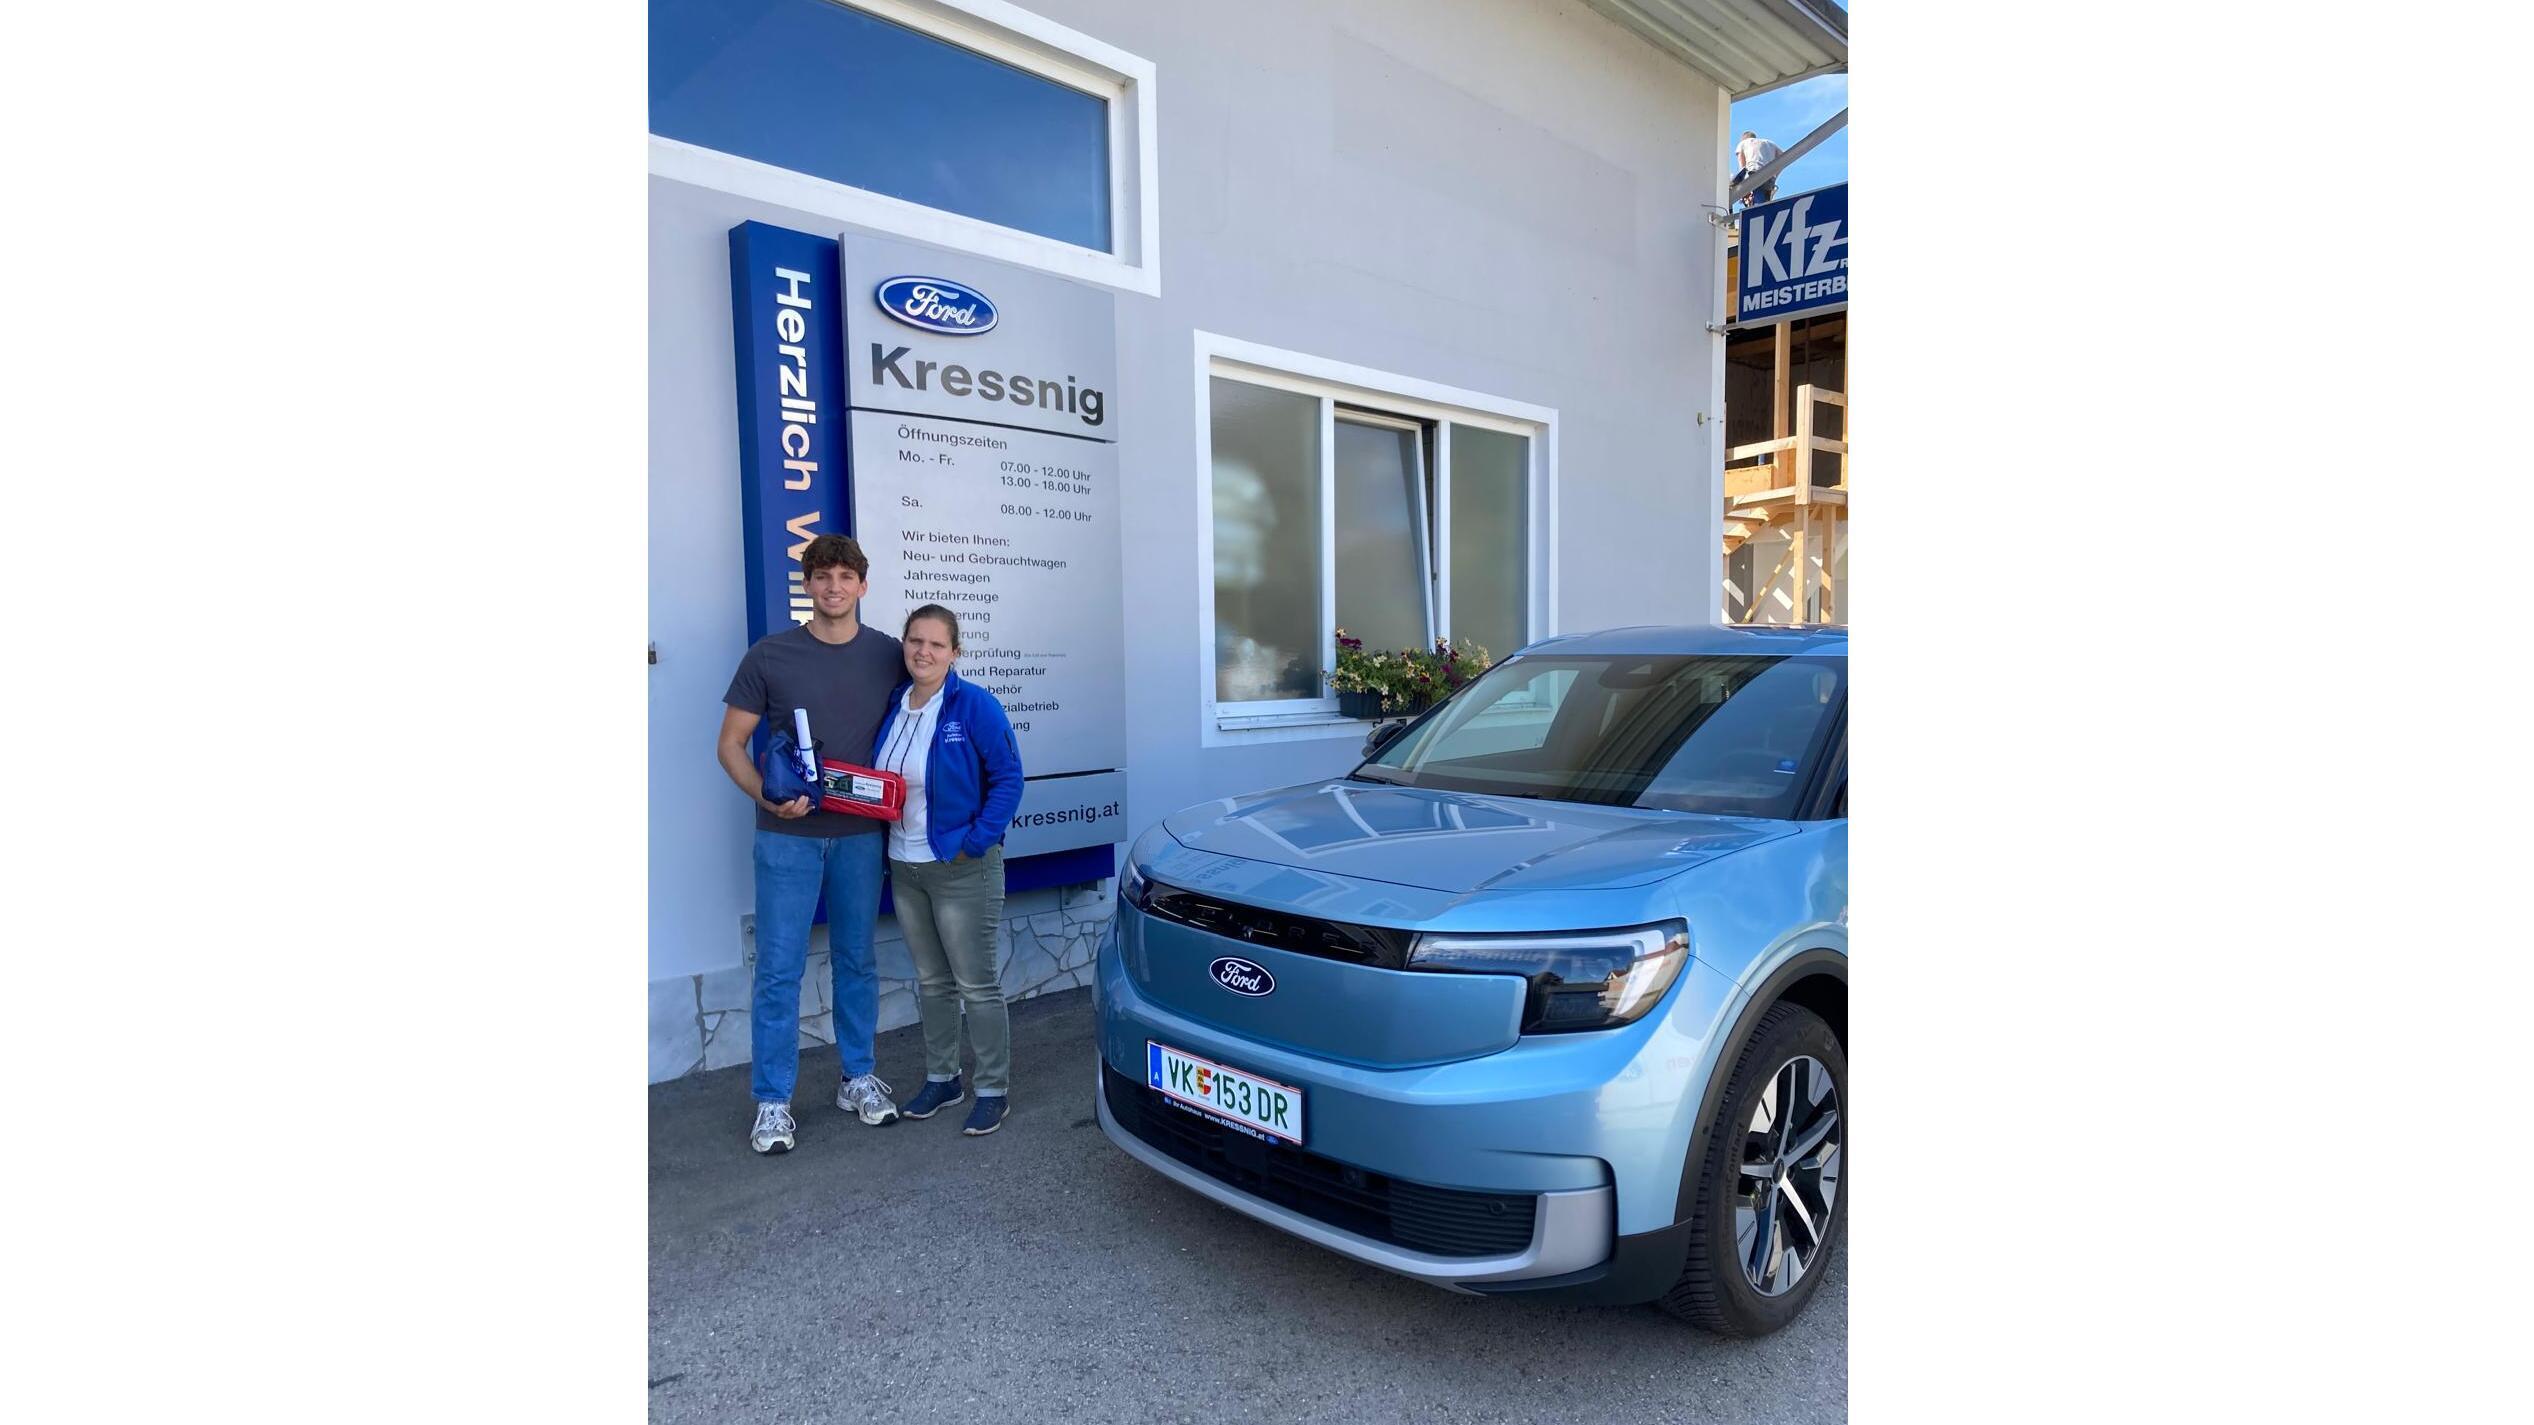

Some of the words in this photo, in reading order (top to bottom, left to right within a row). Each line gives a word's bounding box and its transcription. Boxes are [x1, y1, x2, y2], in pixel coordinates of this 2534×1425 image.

[904, 284, 977, 326] Ford
[1743, 275, 1848, 313] MEISTERB
[775, 266, 819, 491] Herzlich
[871, 342, 1104, 426] Kressnig
[897, 424, 1008, 450] Öffnungszeiten
[899, 450, 925, 463] Mo.
[939, 454, 955, 466] Fr.
[1000, 461, 1031, 474] 07.00
[1042, 466, 1070, 479] 12.00
[1073, 470, 1092, 481] Uhr
[1000, 476, 1031, 488] 13.00
[1042, 481, 1071, 493] 18.00
[1073, 484, 1092, 495] Uhr
[901, 496, 923, 508] Sa.
[1000, 504, 1032, 516] 08.00
[1043, 508, 1072, 520] 12.00
[1074, 511, 1092, 522] Uhr
[902, 530, 926, 542] Wir
[929, 531, 969, 545] bieten
[973, 534, 1010, 547] Ihnen:
[902, 550, 936, 562] Neu-
[940, 552, 965, 563] und
[968, 553, 1067, 570] Gebrauchtwagen
[903, 569, 991, 585] Jahreswagen
[904, 589, 999, 603] Nutzfahrzeuge
[958, 647, 1021, 660] erprüfung
[961, 666, 985, 677] und
[989, 666, 1047, 678] Reparatur
[985, 684, 1023, 695] behör
[1002, 701, 1060, 713] zialbetrieb
[1011, 801, 1120, 829] kressnig.at
[1219, 961, 1261, 992] Ford
[1168, 1055, 1195, 1096] VK
